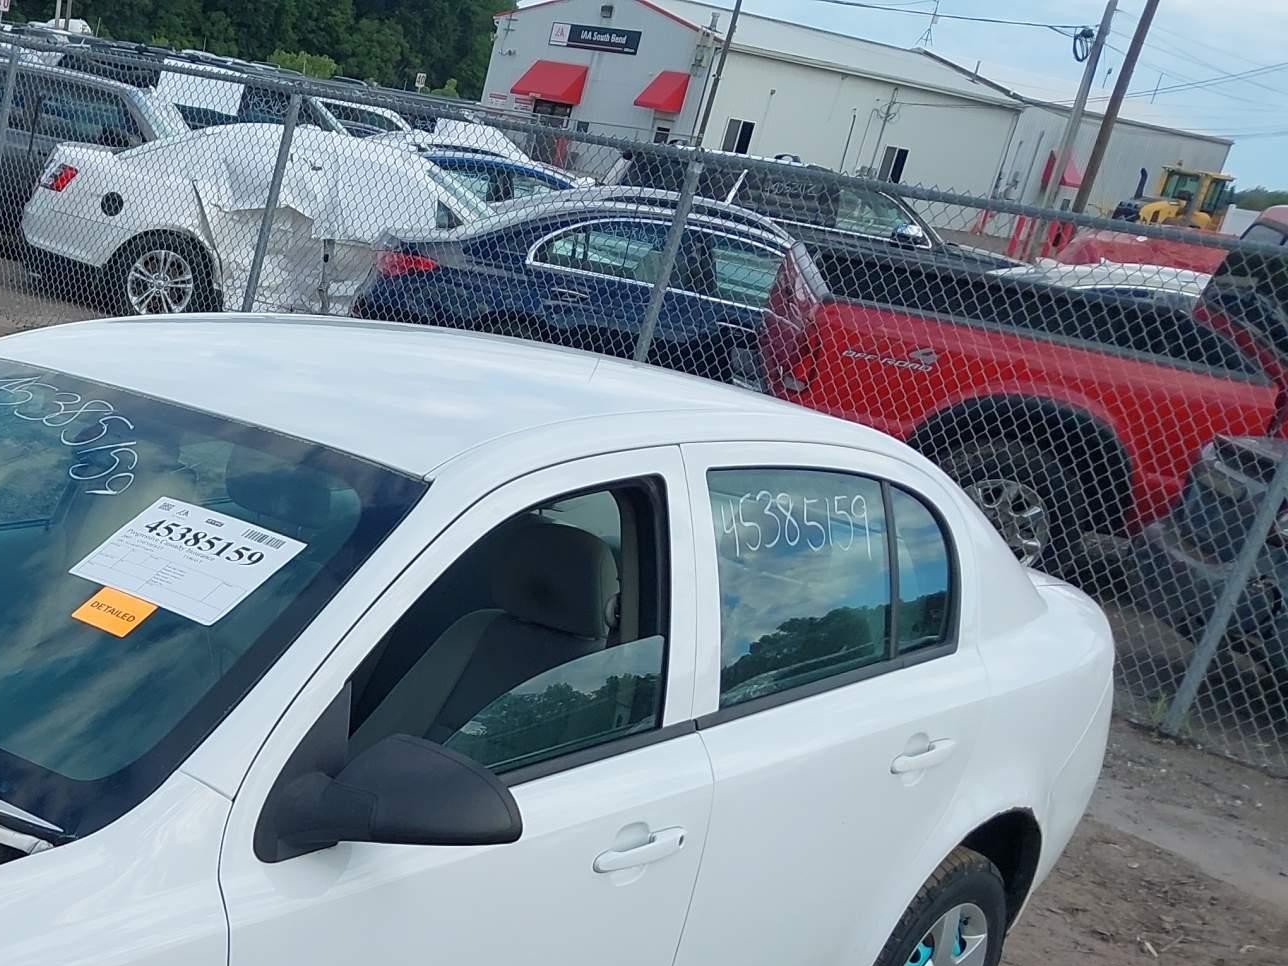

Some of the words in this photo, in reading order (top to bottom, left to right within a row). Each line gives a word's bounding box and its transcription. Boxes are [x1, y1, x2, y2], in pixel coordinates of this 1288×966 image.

[580, 30, 592, 40] IAA
[592, 31, 610, 42] South
[611, 34, 627, 44] Bend
[880, 358, 933, 372] ROAD
[720, 490, 872, 561] 45385159
[144, 519, 265, 566] 45385159
[90, 600, 136, 623] DETAILED
